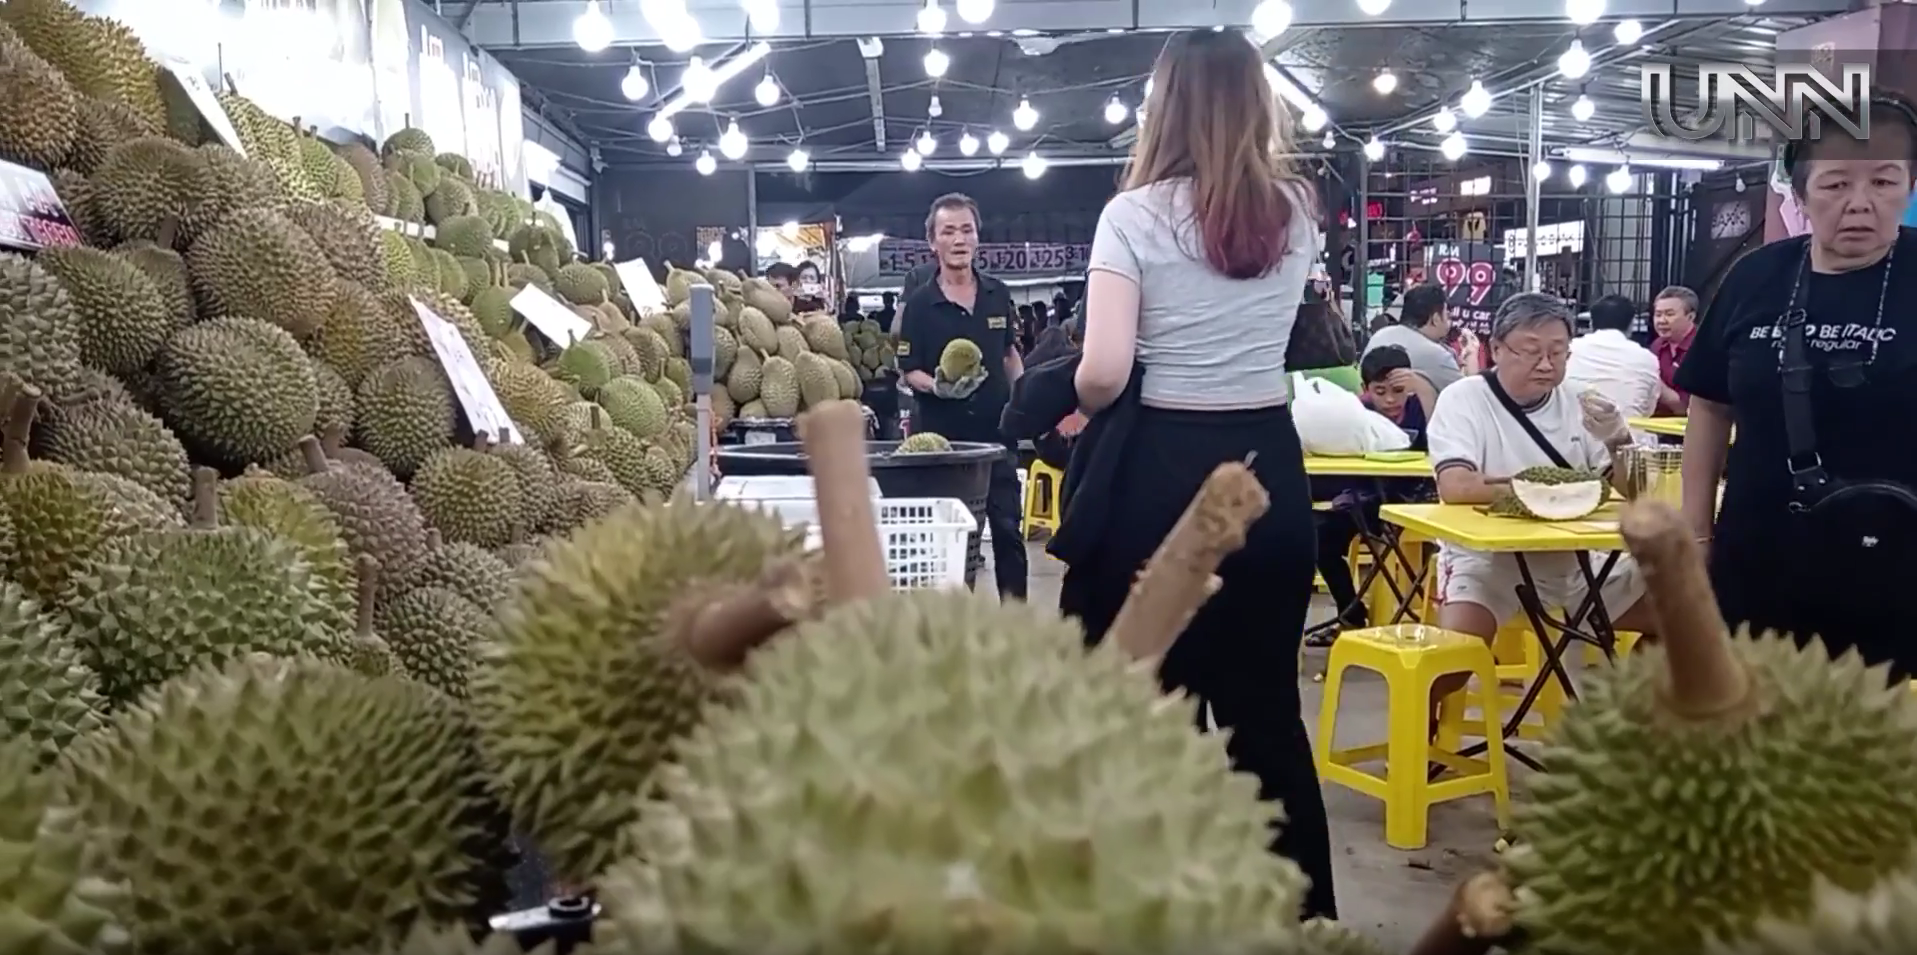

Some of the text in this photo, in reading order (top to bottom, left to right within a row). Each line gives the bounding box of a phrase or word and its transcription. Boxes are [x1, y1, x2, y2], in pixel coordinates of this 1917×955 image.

[1004, 251, 1027, 270] 20
[1042, 249, 1064, 268] 25
[1436, 257, 1497, 306] 99
[1750, 325, 1770, 339] BE
[1819, 324, 1842, 339] BE
[1842, 323, 1897, 342] ITALIC
